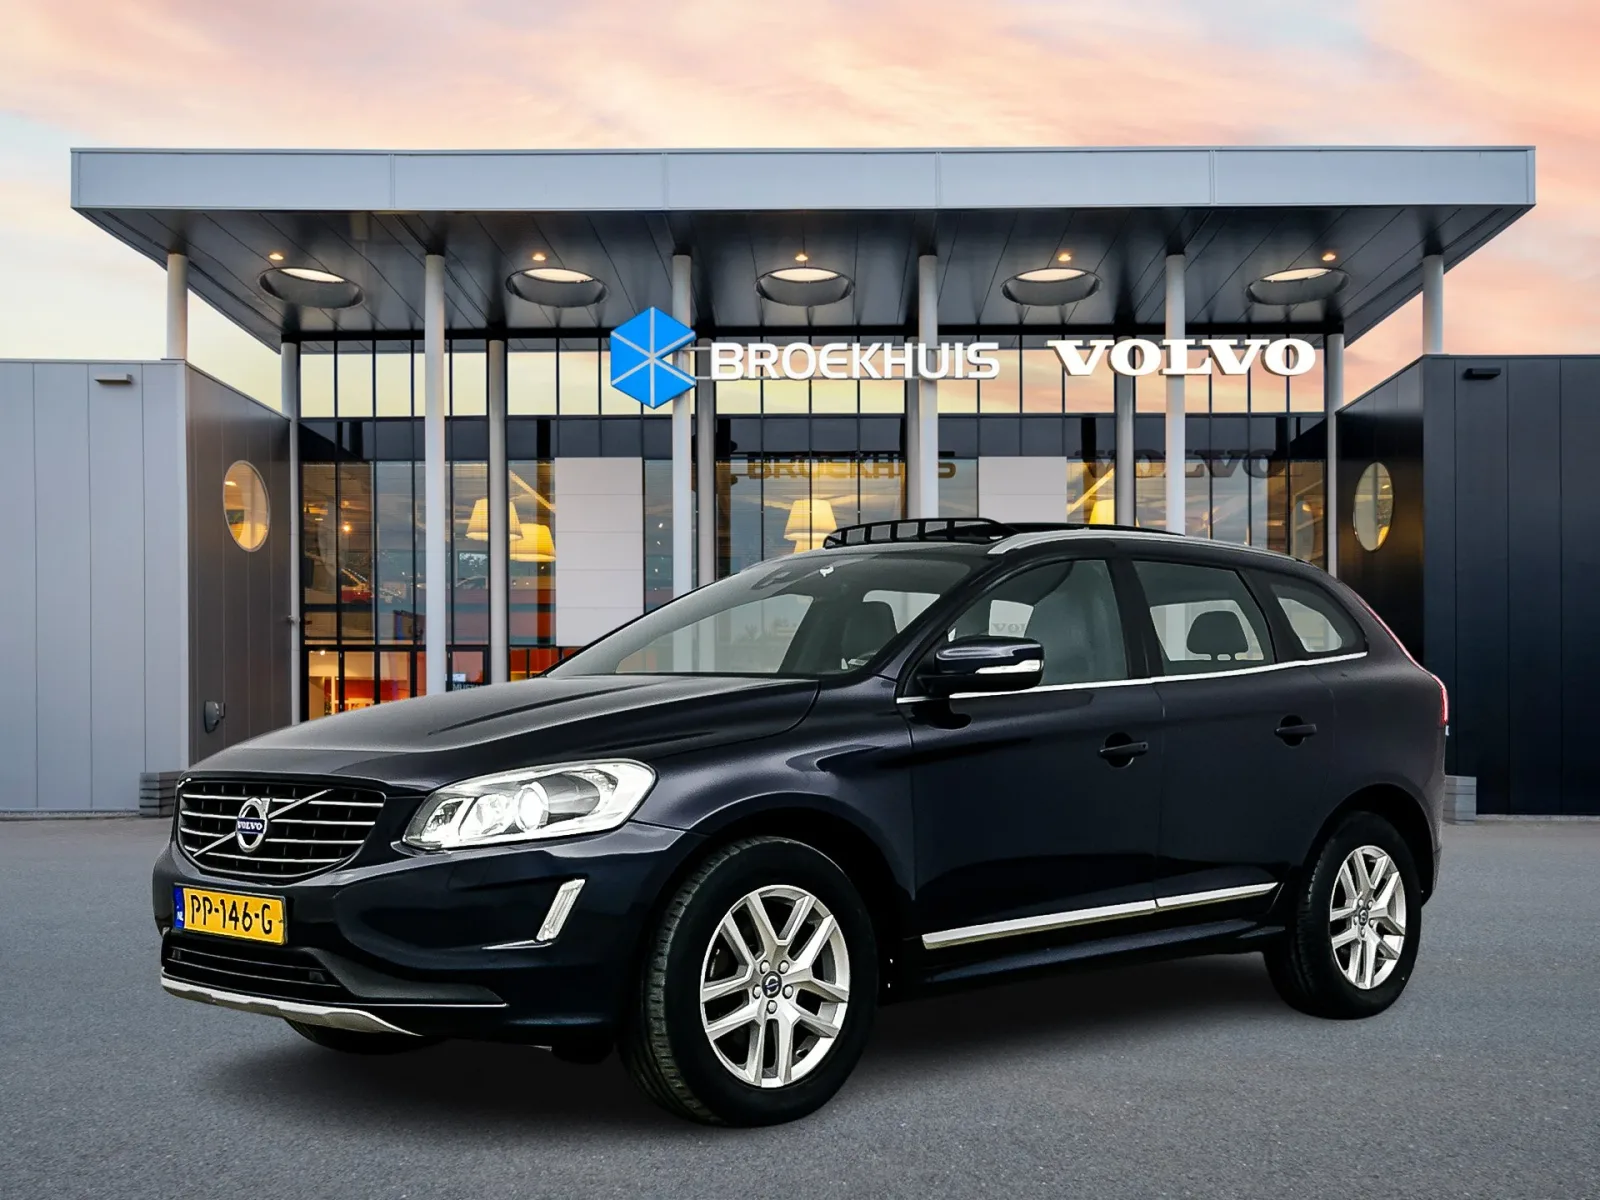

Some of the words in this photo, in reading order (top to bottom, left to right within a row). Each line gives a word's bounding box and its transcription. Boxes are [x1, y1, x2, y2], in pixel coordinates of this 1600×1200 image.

[710, 342, 1000, 380] BROEKHUIS
[1046, 338, 1316, 376] VOLVO
[237, 820, 263, 831] VOLVO
[190, 894, 273, 935] PP-146-G
